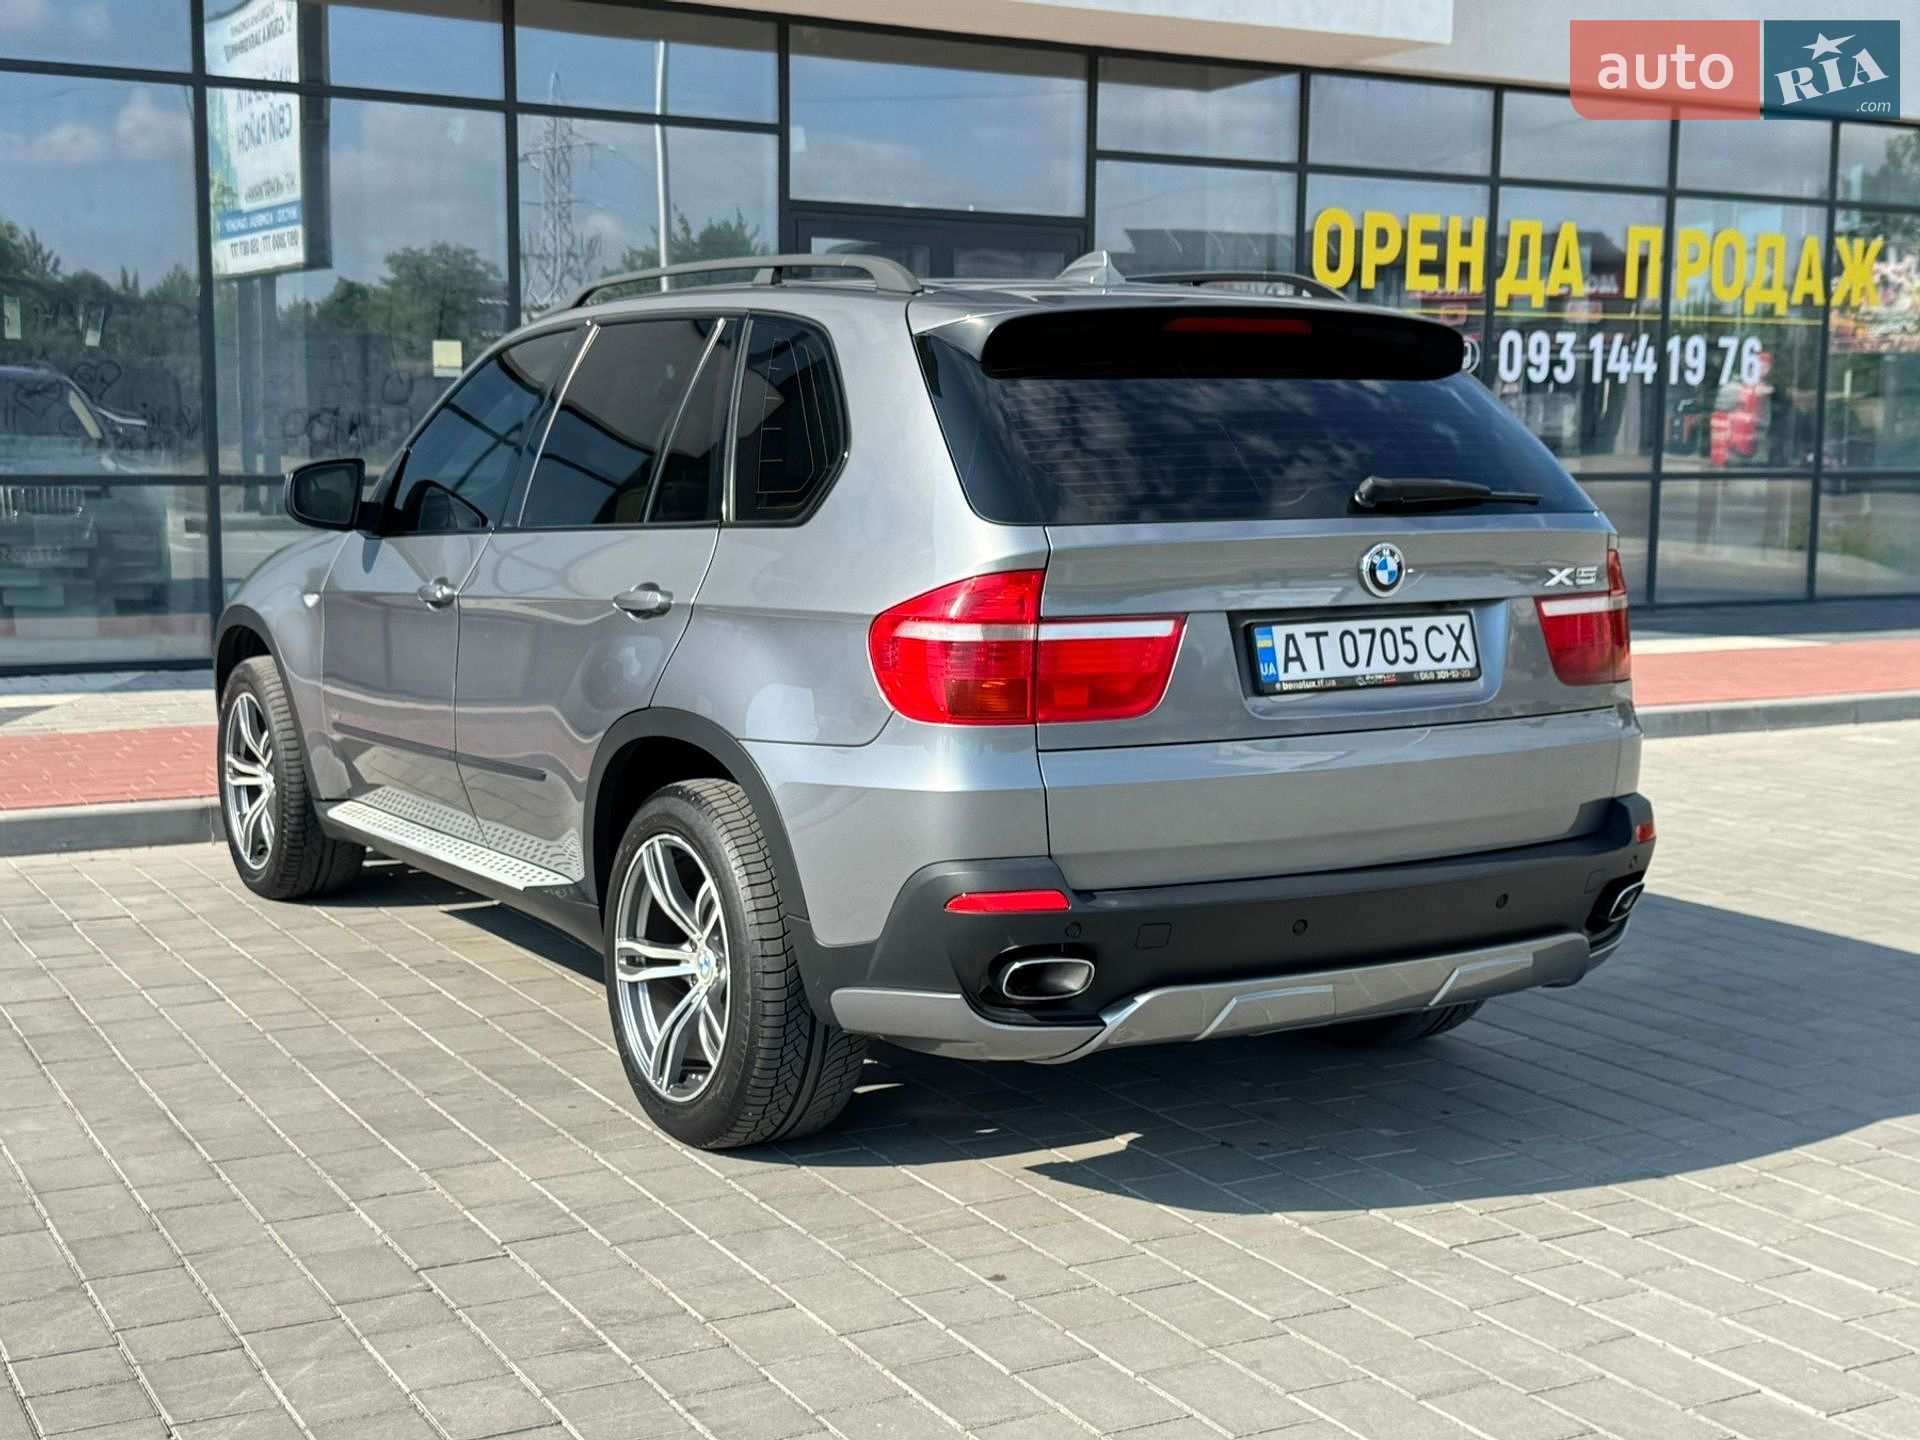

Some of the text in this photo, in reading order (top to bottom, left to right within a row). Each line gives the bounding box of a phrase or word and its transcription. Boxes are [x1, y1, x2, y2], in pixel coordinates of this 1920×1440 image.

[1312, 207, 1885, 316] ОРЕНДА ПРОДАЖ
[1499, 330, 1763, 387] 093 144 19 76
[1543, 566, 1598, 587] X5
[1260, 662, 1277, 676] UA
[1283, 622, 1471, 674] AT 0705 CX
